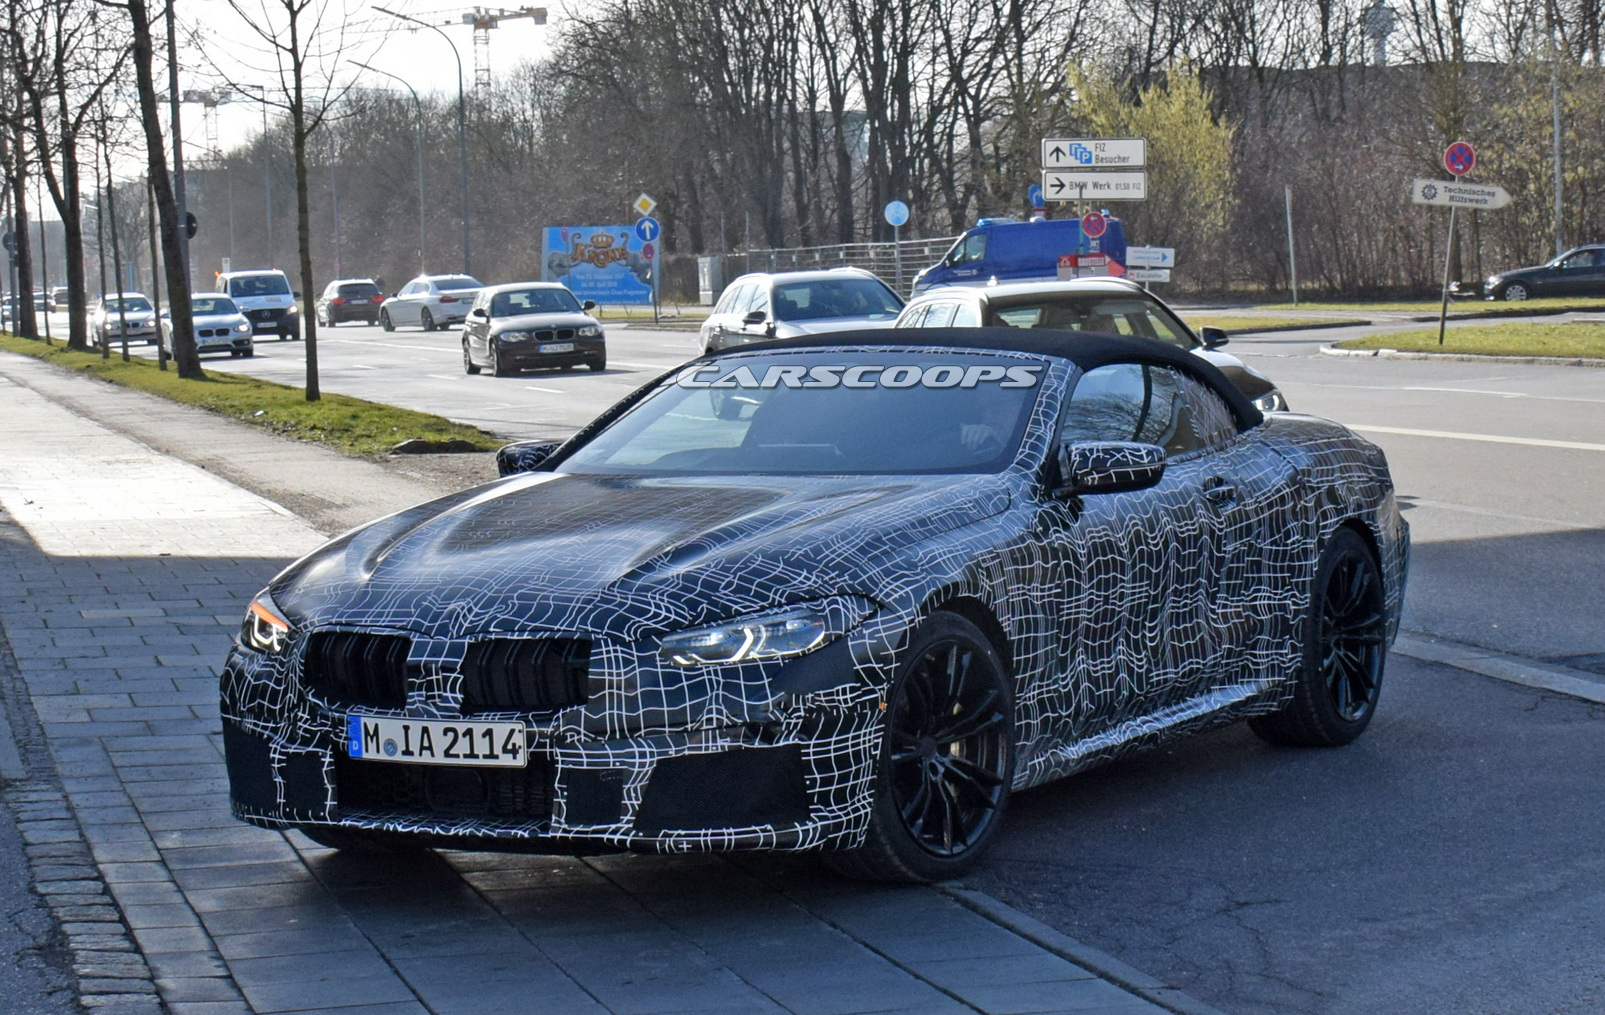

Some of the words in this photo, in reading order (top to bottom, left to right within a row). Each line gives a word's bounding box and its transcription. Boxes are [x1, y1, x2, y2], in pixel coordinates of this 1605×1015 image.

[1095, 143, 1106, 152] FIZ
[1095, 154, 1130, 164] Besucher
[1069, 181, 1088, 190] BMW
[1092, 181, 1112, 190] Werk
[1444, 186, 1496, 197] Technisches
[1449, 195, 1488, 204] Hilfswerk
[363, 721, 380, 754] M
[442, 726, 520, 760] 2114
